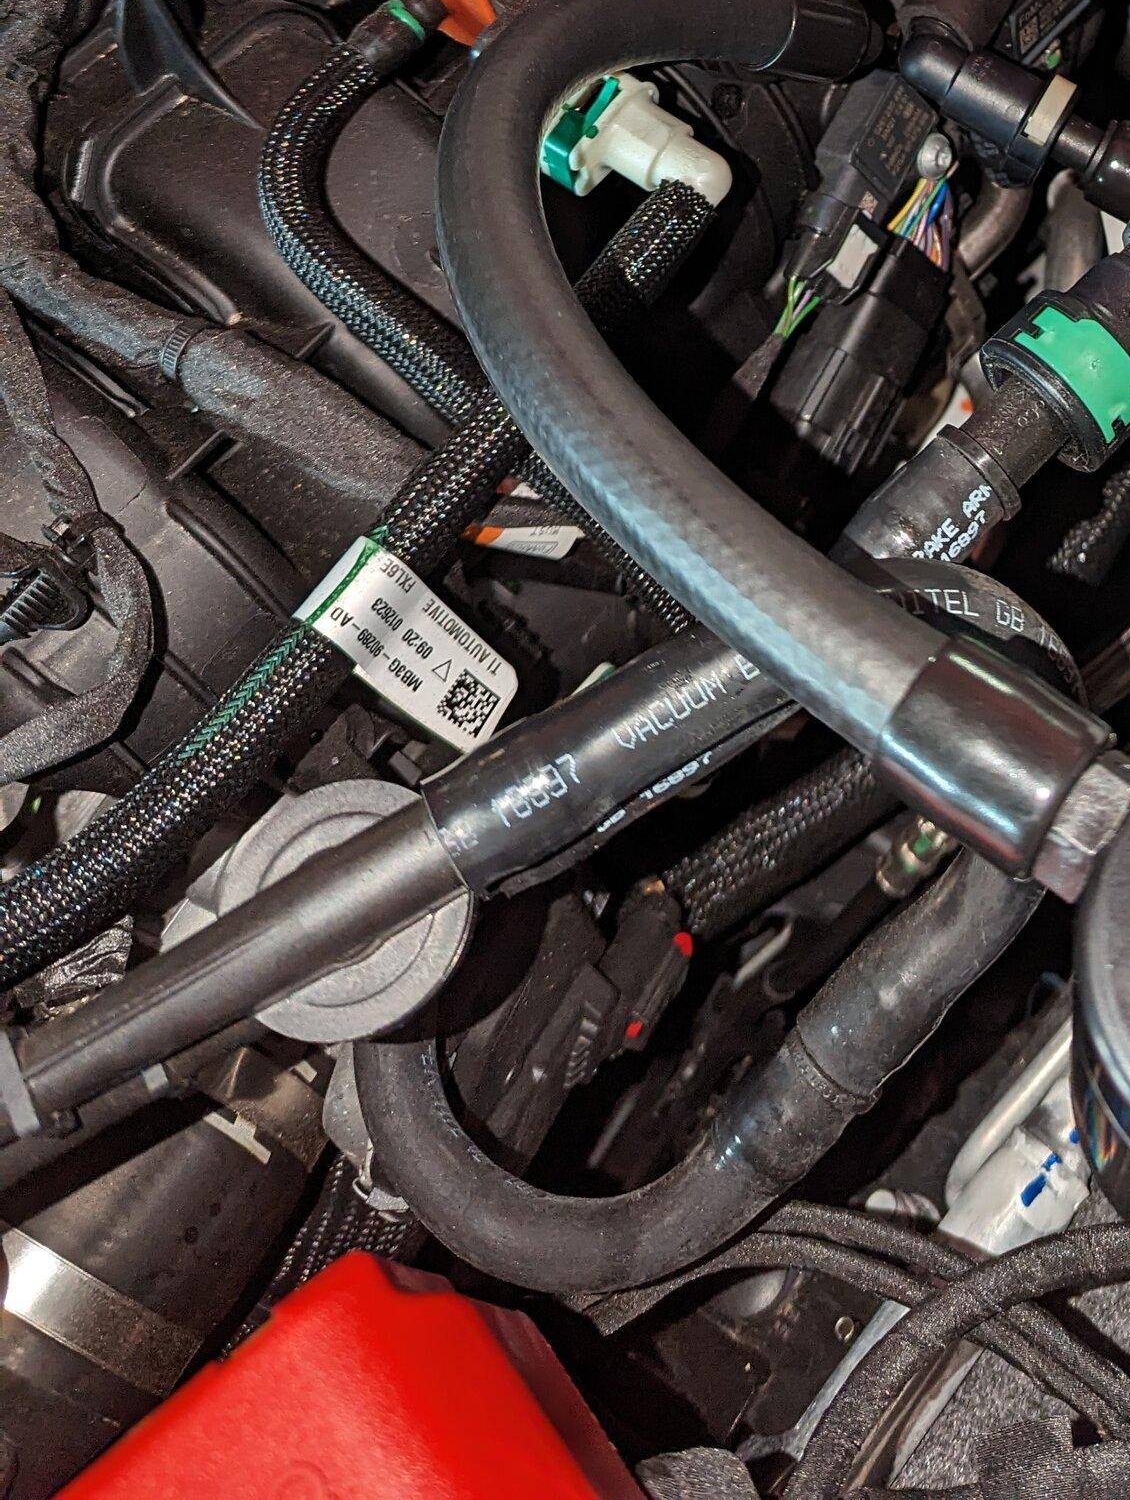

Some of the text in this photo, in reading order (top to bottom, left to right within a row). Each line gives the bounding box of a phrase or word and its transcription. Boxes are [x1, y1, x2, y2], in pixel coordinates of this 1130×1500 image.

[370, 596, 433, 660] 09:20 012623
[422, 597, 491, 665] AUTOMOTIVE
[486, 658, 503, 676] TI
[611, 670, 727, 750] VACUUM
